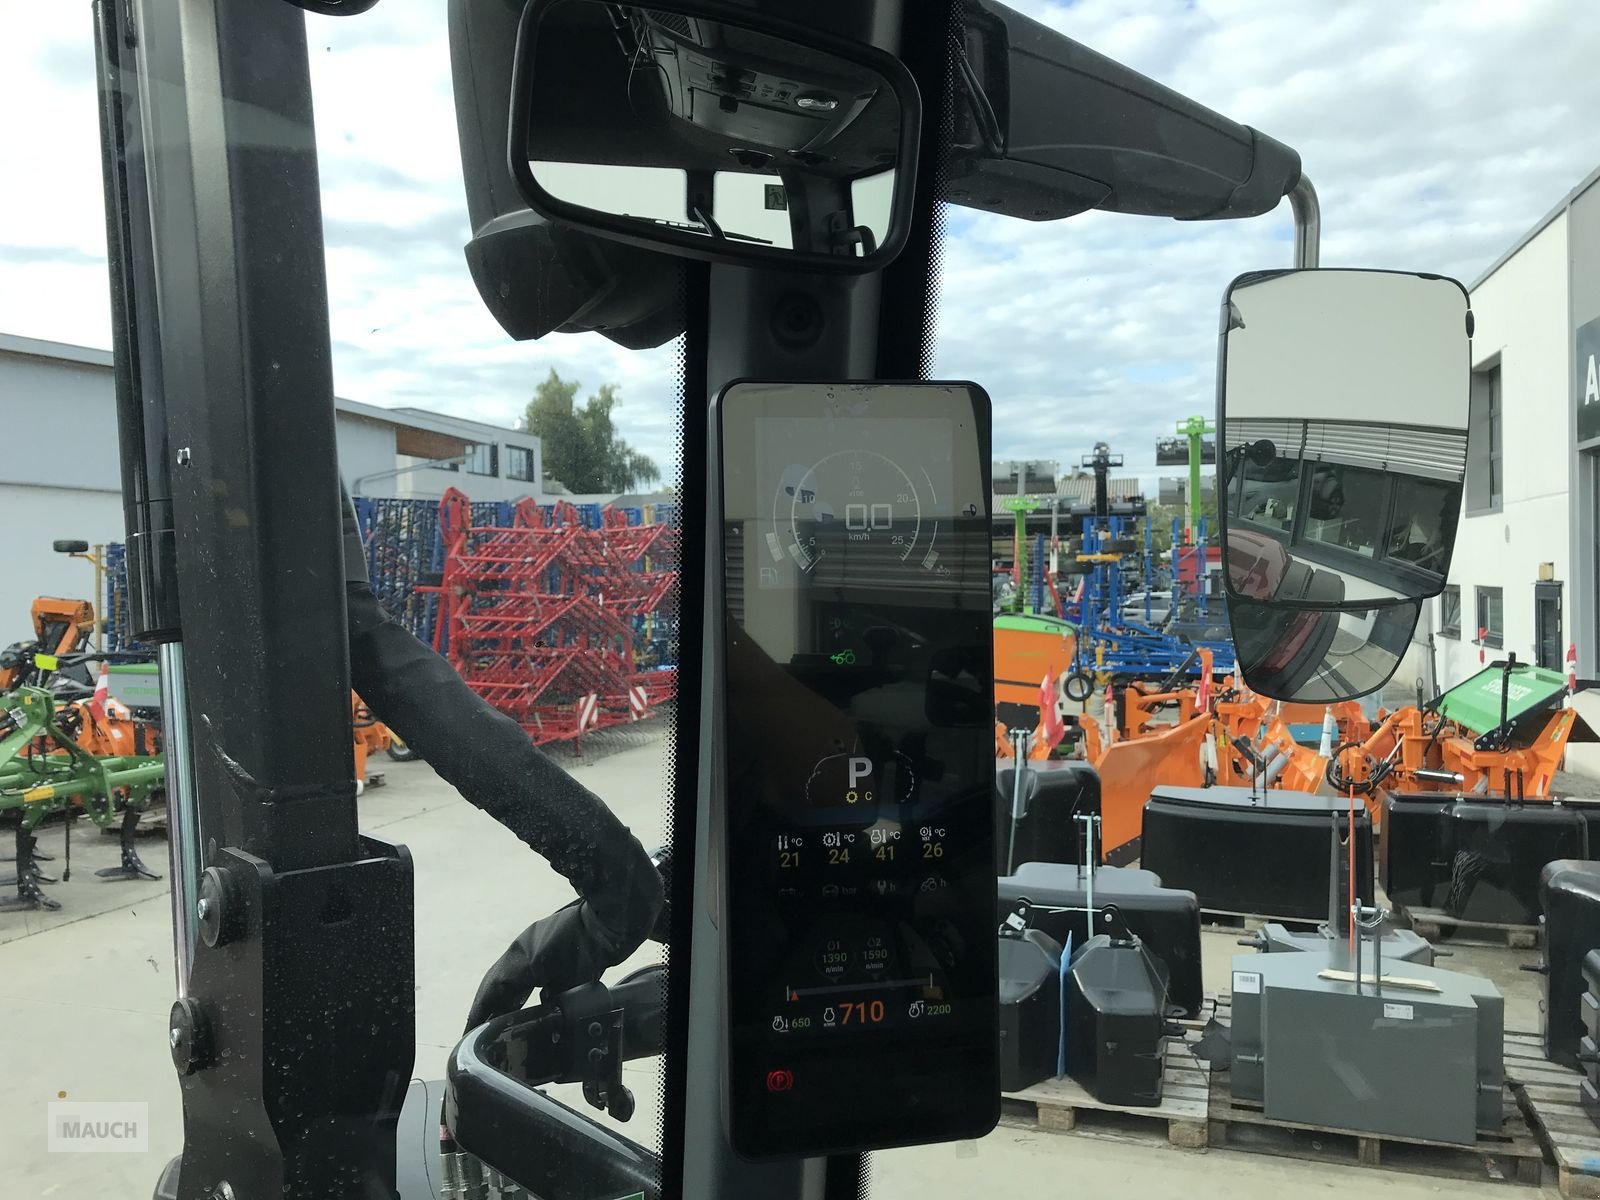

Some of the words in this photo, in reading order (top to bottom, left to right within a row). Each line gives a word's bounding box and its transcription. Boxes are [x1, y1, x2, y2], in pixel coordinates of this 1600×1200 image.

[1584, 353, 1600, 405] A
[803, 494, 816, 504] 10
[896, 494, 909, 503] 20
[845, 503, 893, 532] 0.0
[809, 536, 816, 546] 5
[848, 532, 870, 542] km/h
[891, 536, 904, 545] 25
[848, 757, 873, 788] P
[864, 791, 873, 801] C
[828, 848, 850, 865] 24
[875, 845, 894, 861] 41
[922, 842, 943, 859] 26
[780, 851, 800, 868] 21
[822, 952, 848, 963] 1390
[862, 949, 888, 960] 1590
[839, 1000, 885, 1025] 710
[927, 1004, 951, 1016] 2200
[791, 1017, 811, 1029] 650
